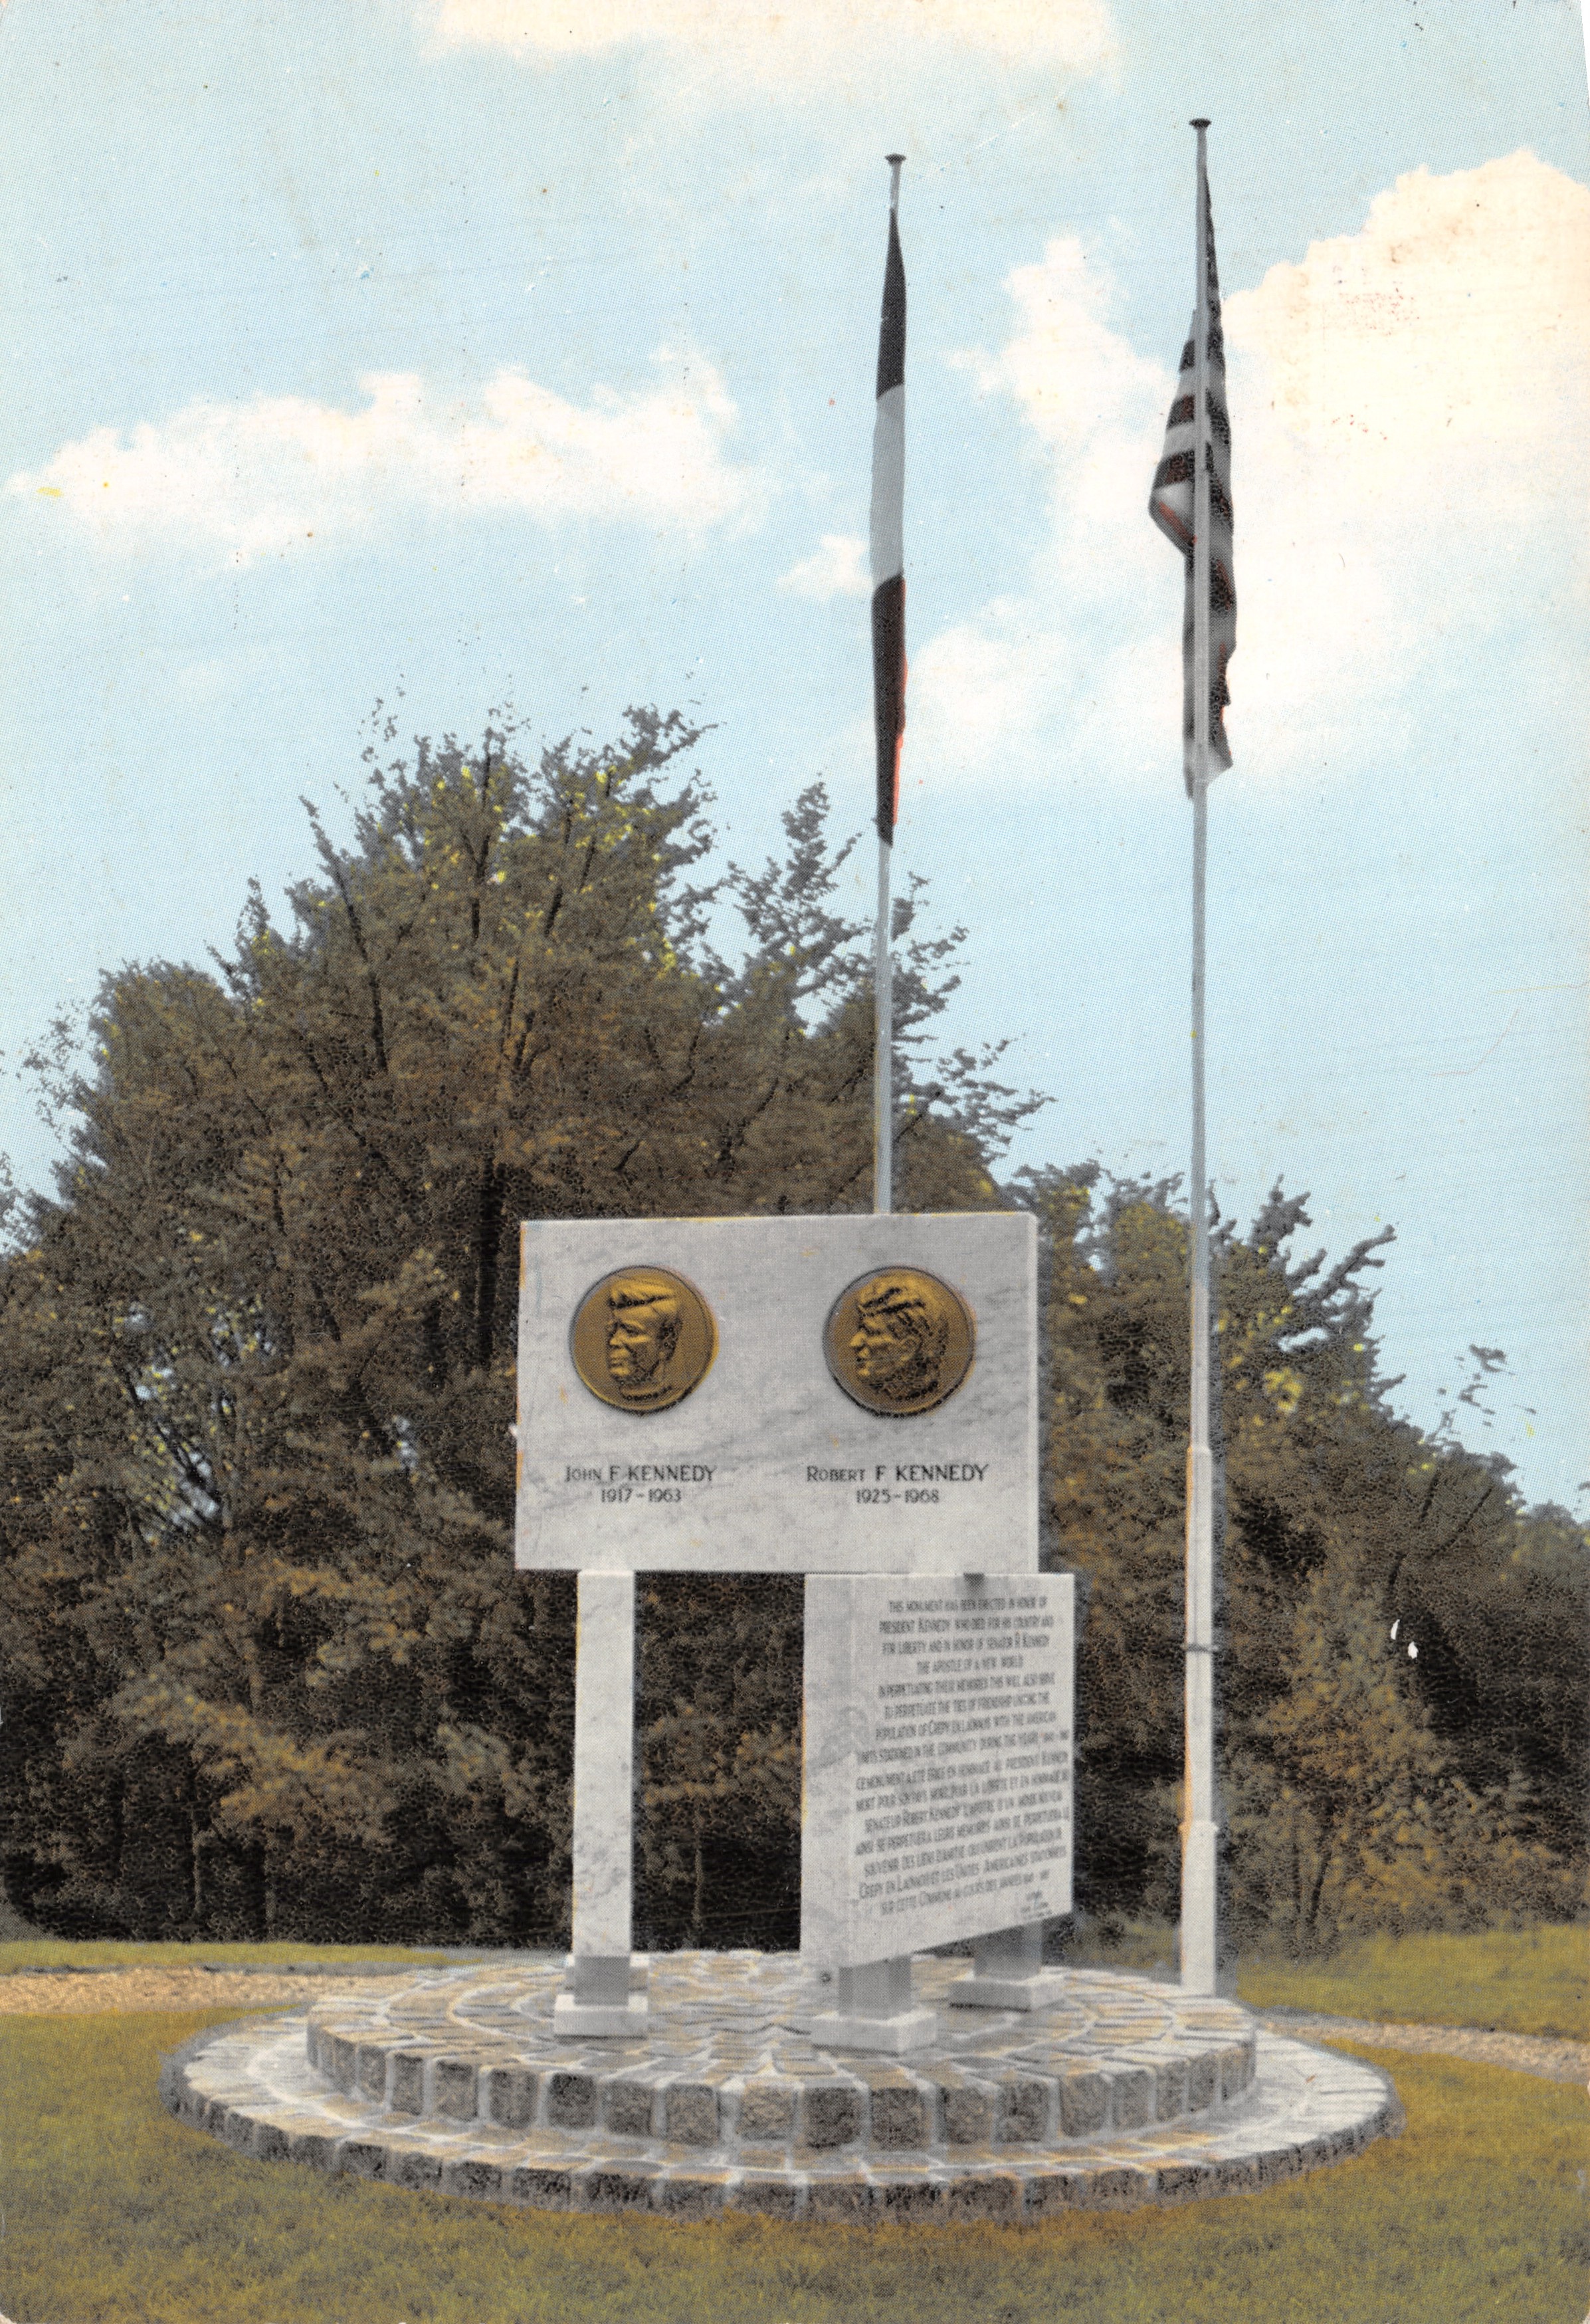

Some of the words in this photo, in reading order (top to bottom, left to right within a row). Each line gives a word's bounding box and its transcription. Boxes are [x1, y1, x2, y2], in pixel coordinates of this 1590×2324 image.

[609, 1465, 620, 1481] F
[627, 1464, 718, 1482] KENNEDY
[874, 1464, 886, 1481] F
[896, 1463, 989, 1481] KENNEDY
